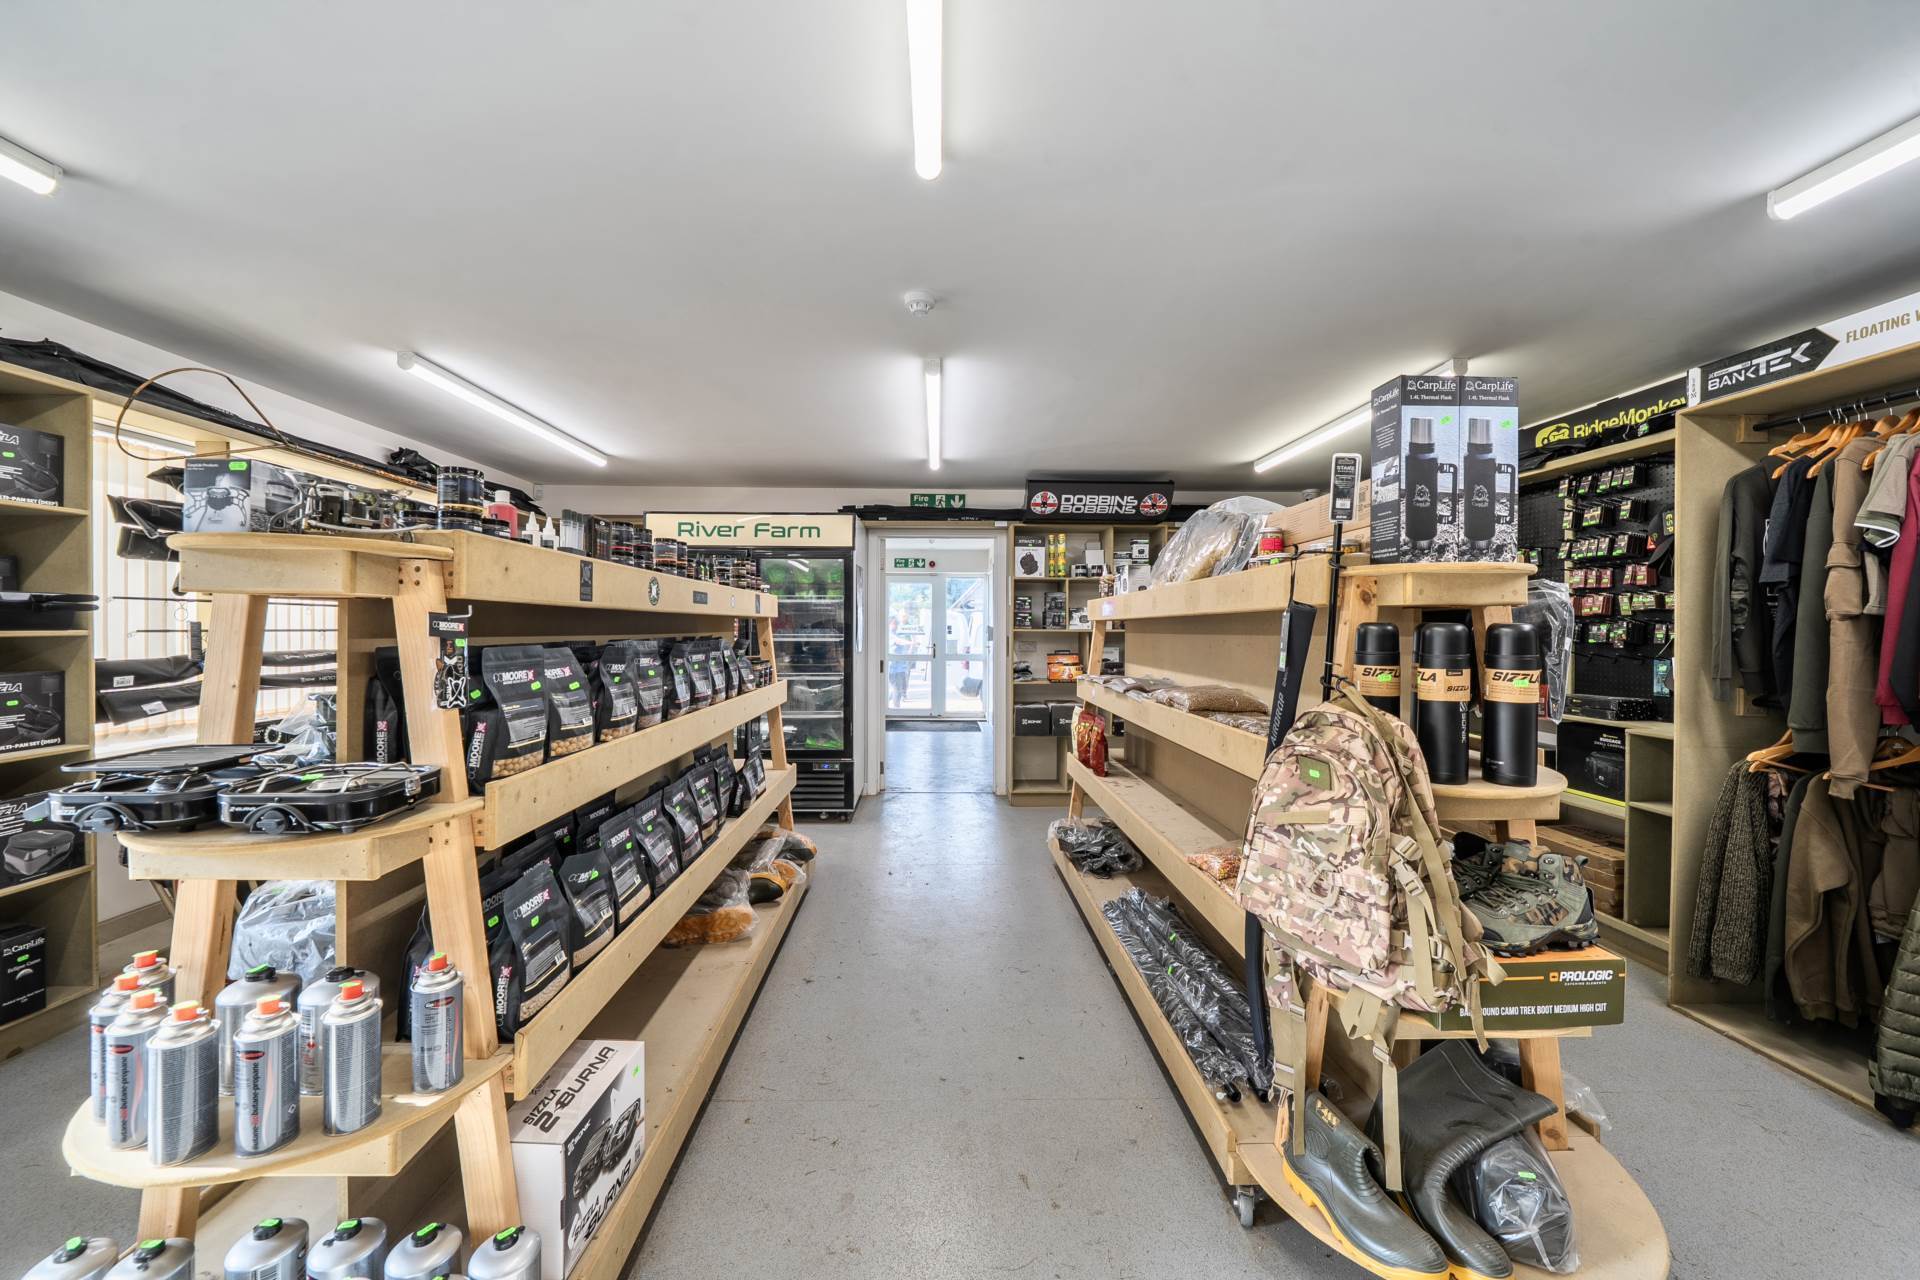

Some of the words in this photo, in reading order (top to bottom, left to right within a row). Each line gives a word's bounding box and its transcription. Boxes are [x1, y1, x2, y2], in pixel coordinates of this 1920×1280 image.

[1846, 313, 1911, 343] FLOATING
[1417, 380, 1457, 392] CarpLife
[1475, 381, 1514, 392] CarpLife
[913, 494, 929, 502] Fire
[1061, 494, 1138, 506] DOBBINS
[1060, 505, 1136, 514] BOBBINS
[677, 521, 745, 538] River
[754, 522, 821, 538] Farm
[1269, 692, 1285, 747] AIRDROP
[11, 936, 46, 953] CarpLife
[1559, 970, 1613, 982] PROLOGIC
[1501, 1006, 1519, 1016] CAMO
[1520, 1006, 1536, 1015] TREK
[1537, 1005, 1554, 1014] BOOT
[1554, 1004, 1579, 1013] MEDIUM
[1580, 1003, 1595, 1012] HIGH
[1595, 1002, 1608, 1012] CUT
[522, 1088, 561, 1125] SIZZLA
